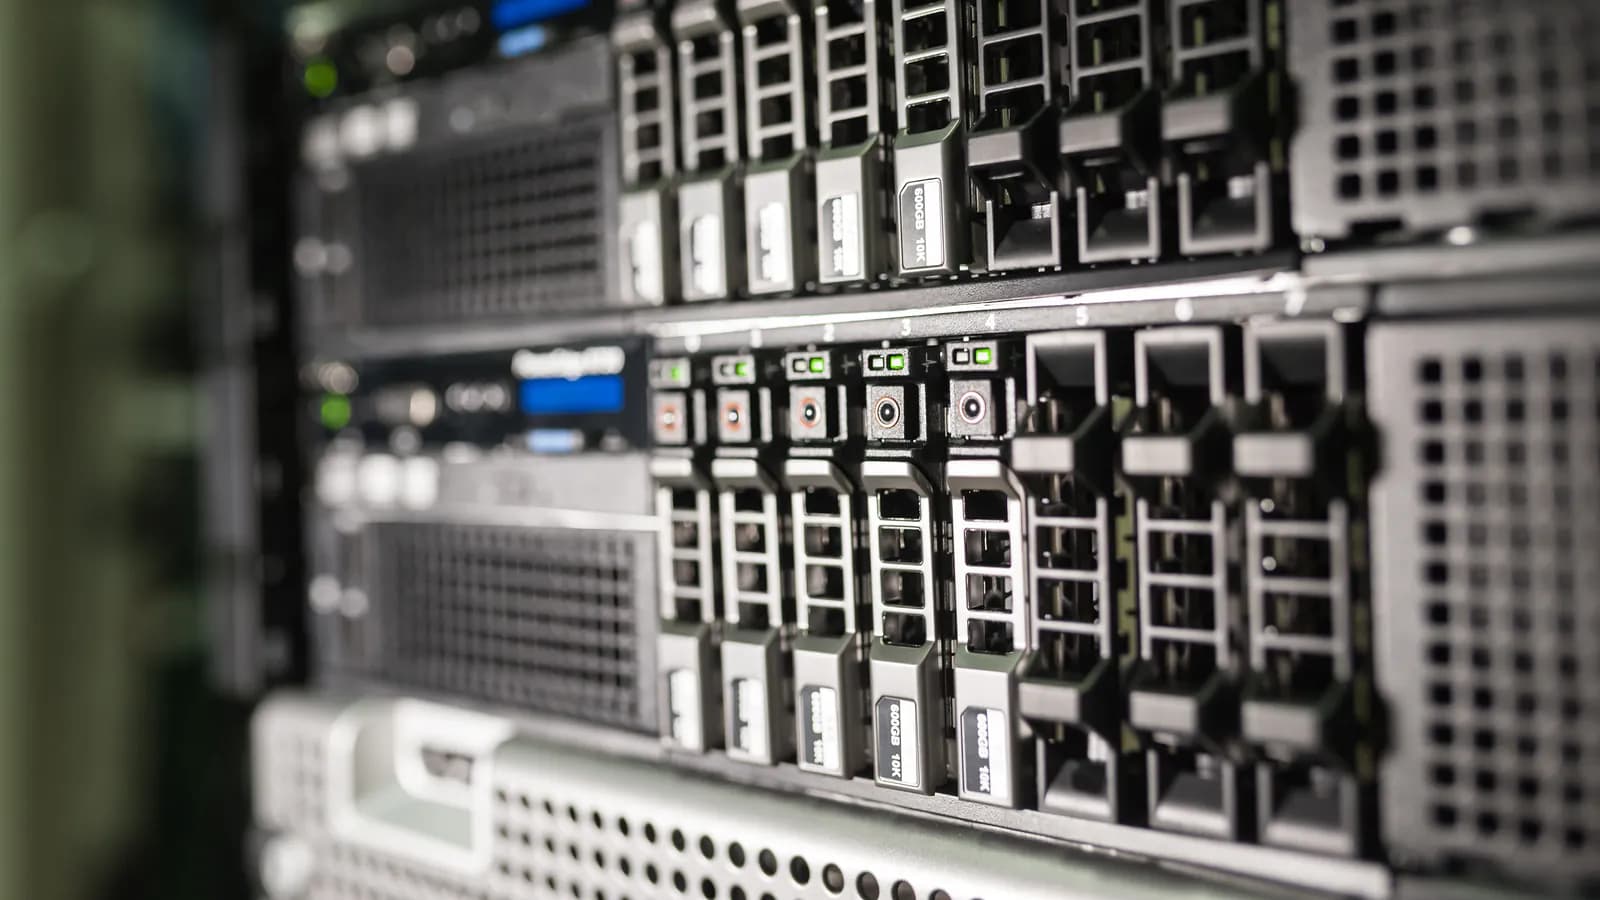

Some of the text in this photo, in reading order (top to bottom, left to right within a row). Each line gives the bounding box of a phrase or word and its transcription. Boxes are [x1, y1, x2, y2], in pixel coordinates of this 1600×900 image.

[914, 186, 926, 262] 600GB 10K
[823, 324, 835, 342] 2
[901, 318, 912, 336] 3
[985, 313, 997, 330] 4
[1075, 305, 1089, 326] 5
[889, 703, 902, 779] 600GB 10K
[976, 713, 991, 794] 600GB 10K
